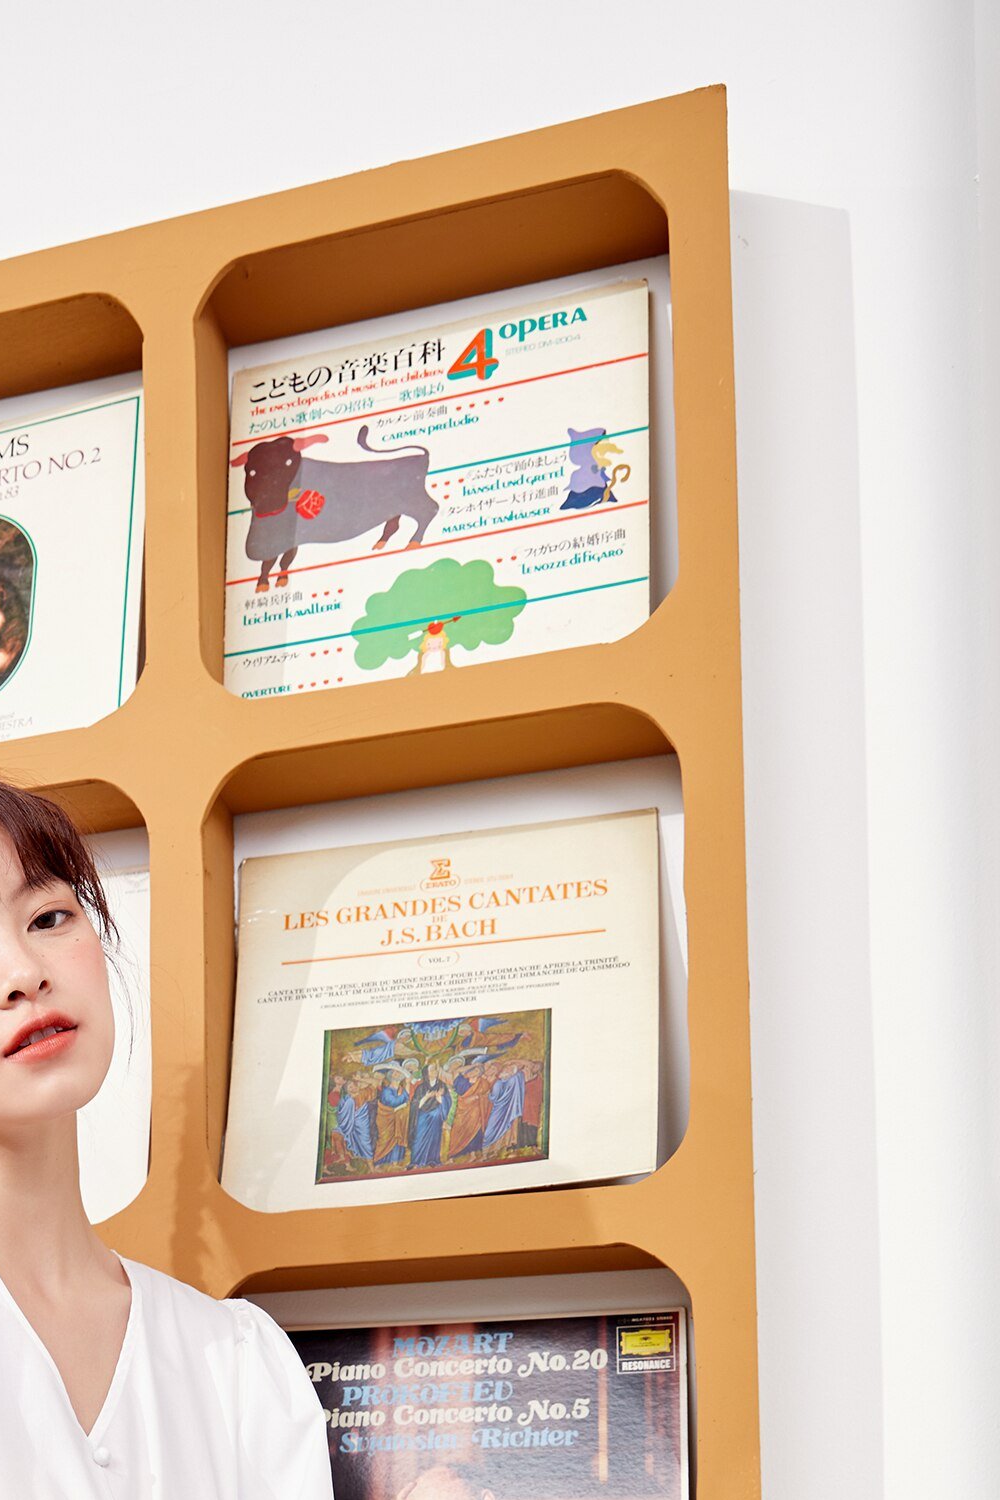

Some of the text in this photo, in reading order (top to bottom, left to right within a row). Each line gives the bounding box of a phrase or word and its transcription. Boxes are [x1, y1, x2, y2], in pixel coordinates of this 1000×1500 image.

[446, 328, 500, 381] 4
[250, 338, 446, 403] こどもの音楽百科
[376, 405, 448, 429] カルメン前奏曲
[524, 528, 627, 558] フィガロの結婚序曲
[241, 685, 292, 699] OVERTURE
[283, 879, 609, 931] LES GRANDES CANTATES
[431, 915, 448, 924] DE
[380, 918, 497, 947] J.S. BACH
[257, 995, 294, 1004] CANTATE
[483, 974, 506, 982] POUR
[519, 968, 565, 978] DIMANCHE
[579, 961, 631, 972] QUASIMODO
[268, 987, 305, 997] CANTATE
[450, 971, 473, 979] POUR
[497, 964, 541, 975] DIMANCHE
[415, 999, 440, 1007] FRITZ
[441, 996, 477, 1004] WERNER
[392, 1332, 514, 1358] MOZART
[306, 1348, 609, 1382] Piano Concerto No.20
[621, 1359, 672, 1371] RESONANCE
[393, 1402, 514, 1426] Concerto
[517, 1397, 591, 1427] No.5
[471, 1425, 579, 1450] Richter
